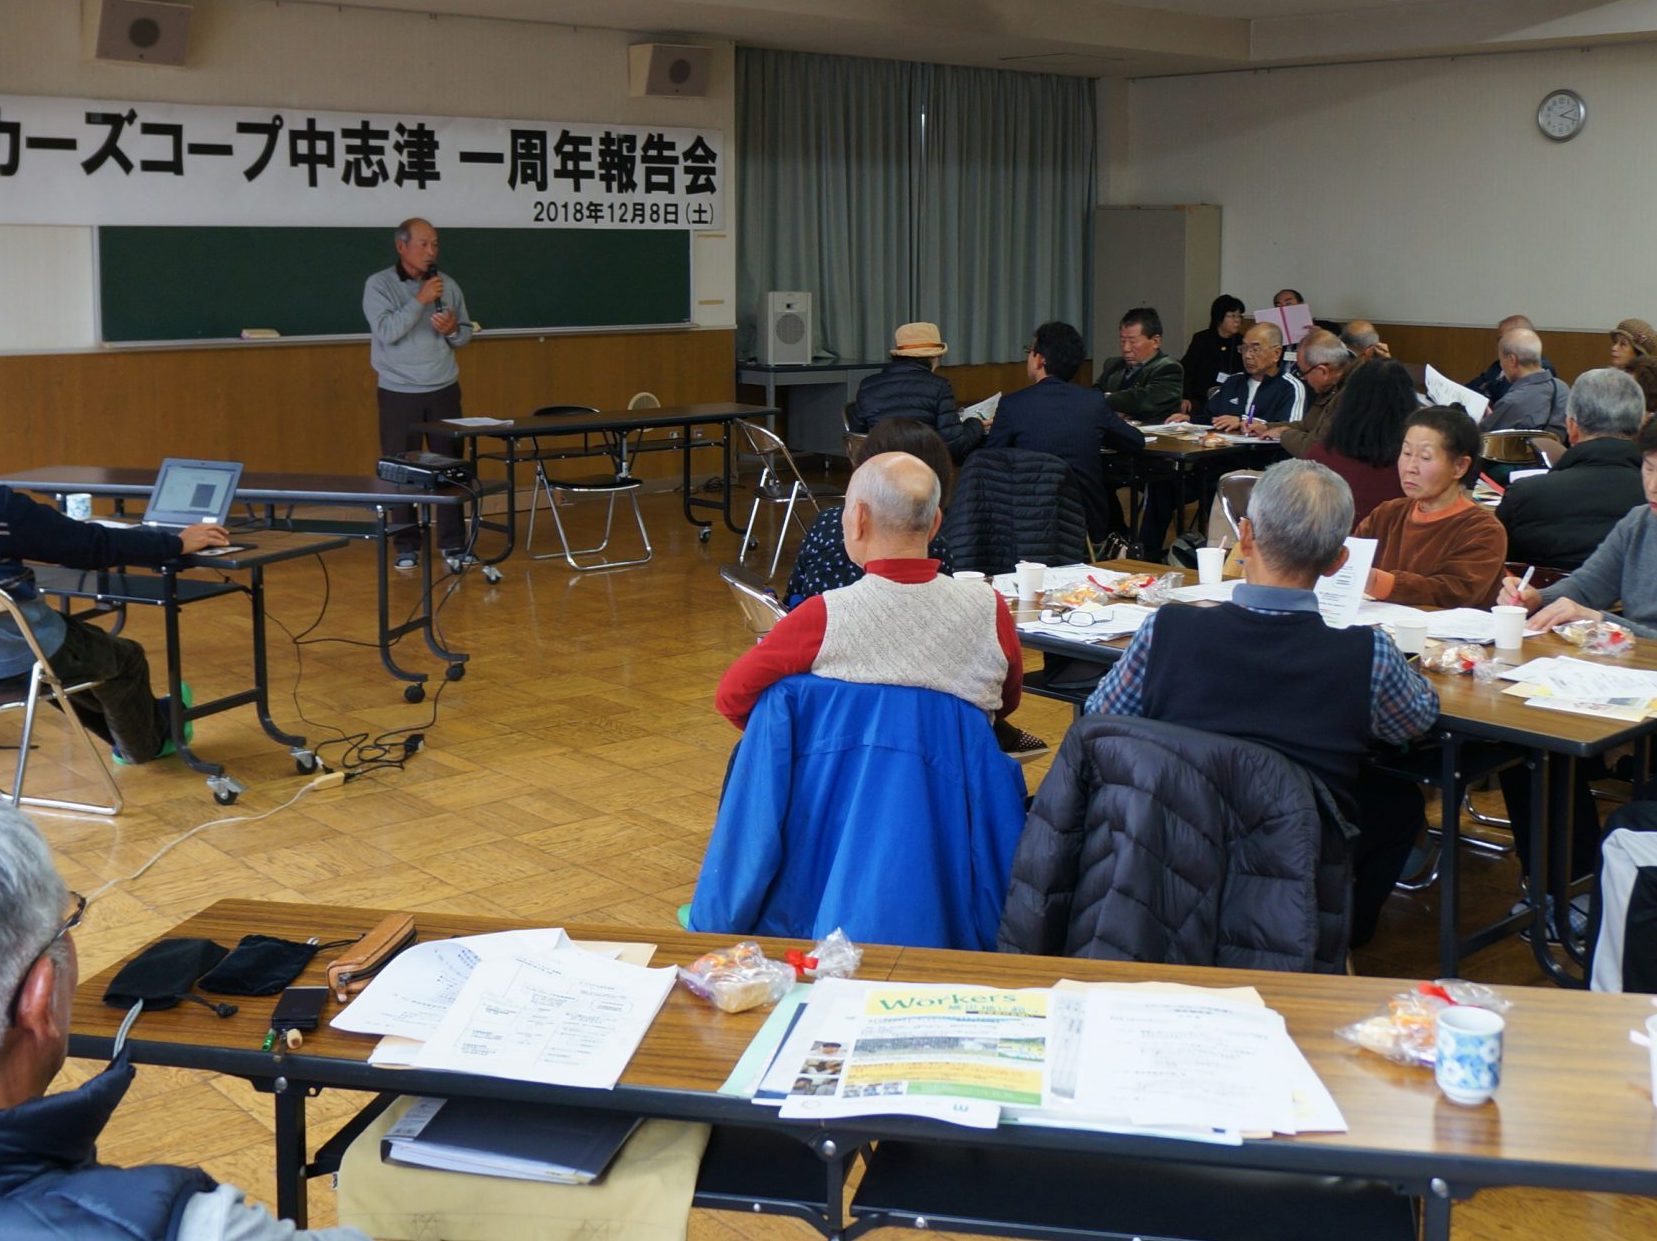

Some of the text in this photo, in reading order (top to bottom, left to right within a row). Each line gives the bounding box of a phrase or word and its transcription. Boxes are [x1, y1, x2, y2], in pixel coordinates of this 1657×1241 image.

[459, 129, 717, 194] 一周年報告会
[533, 201, 714, 224] 2018年12月8日(土)
[880, 994, 1016, 1011] Workers
